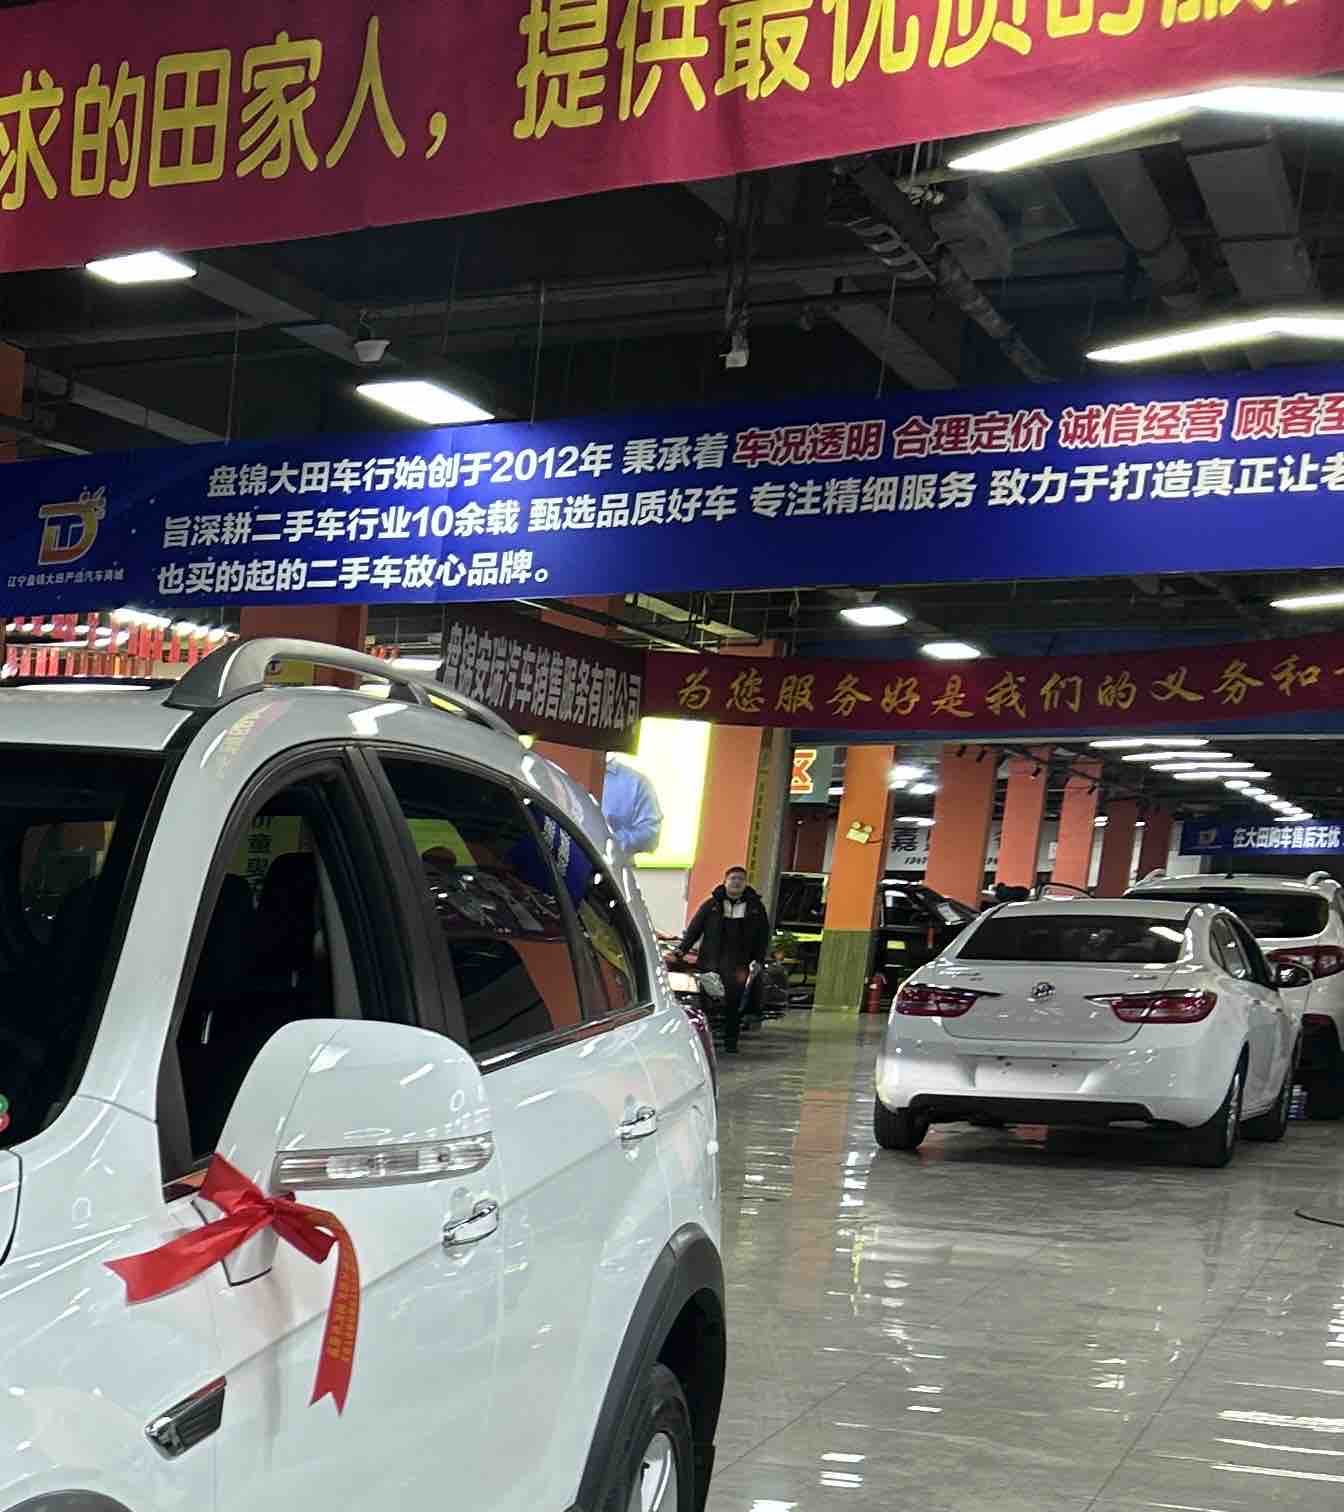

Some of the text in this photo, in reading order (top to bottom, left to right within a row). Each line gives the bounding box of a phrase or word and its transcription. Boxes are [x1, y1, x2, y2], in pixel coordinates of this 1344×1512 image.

[208, 443, 613, 499] 盘锦大田车行始创于2012年
[892, 408, 1052, 461] 合理定价
[1059, 398, 1227, 446] 诚信经营
[162, 455, 1344, 550] 旨深耕二手车行业10余载 甄选品质好车 专注精细服务 致力于打造真正让老
[157, 549, 550, 595] 也买的起的二手车放心品牌。
[679, 653, 1344, 720] 为您服务好是我们的义务和
